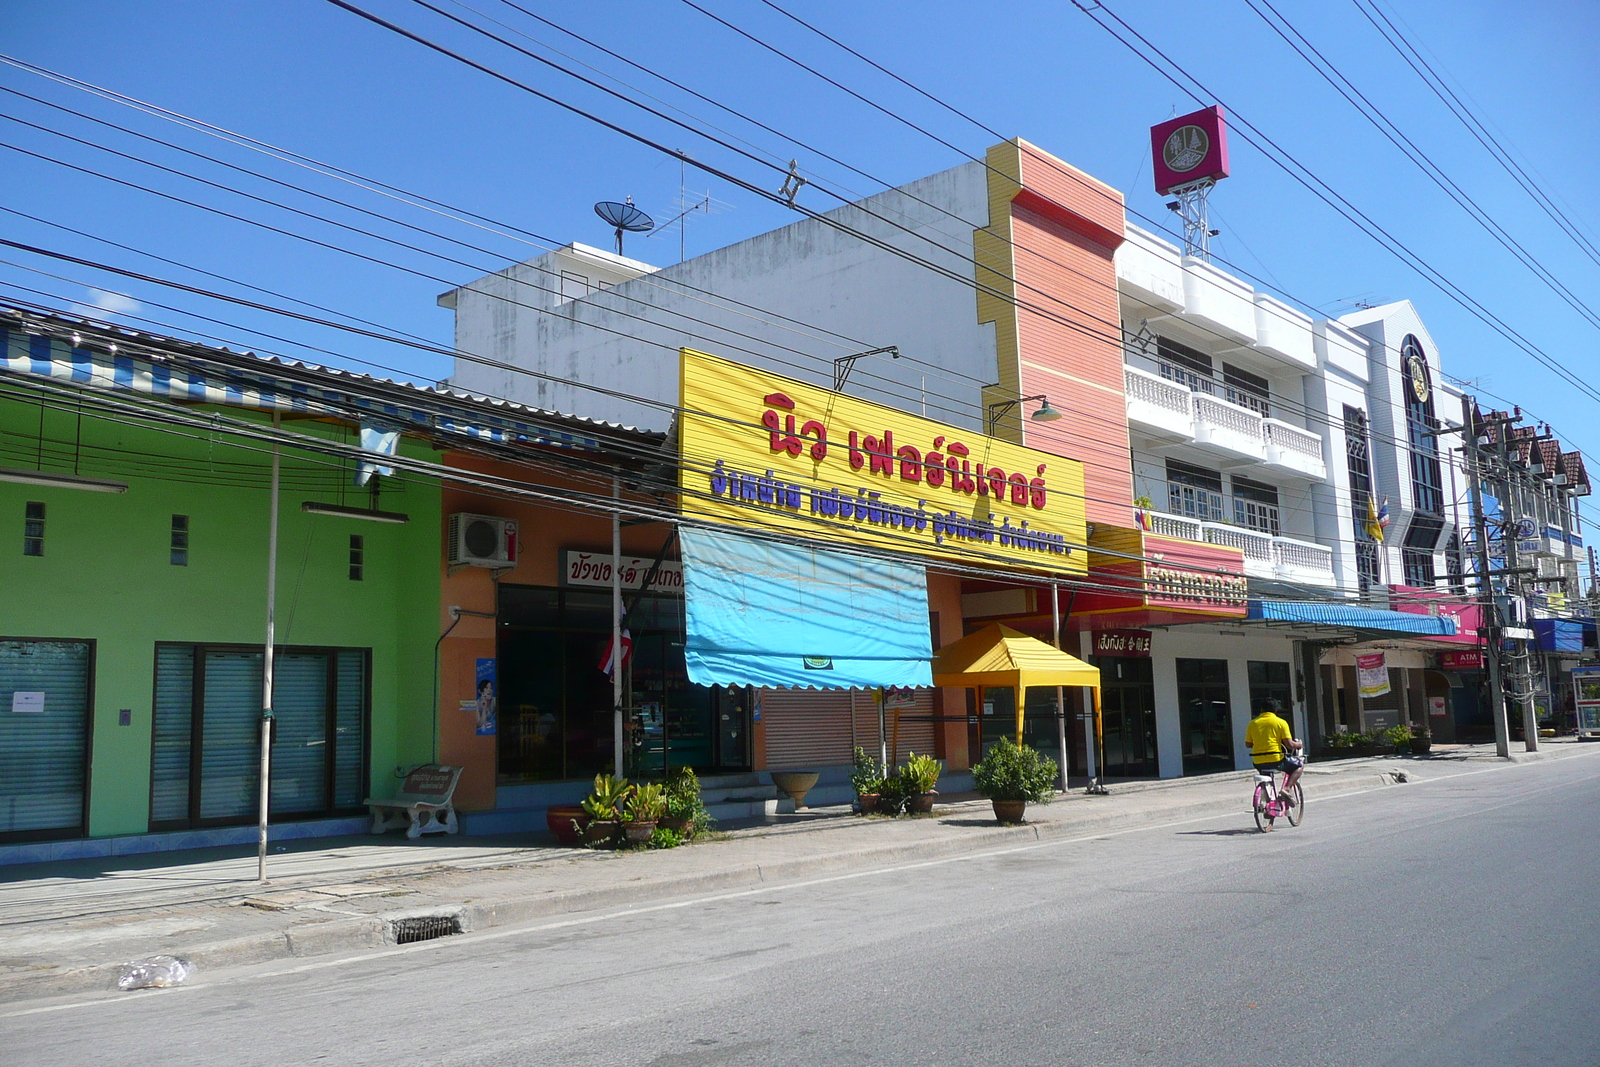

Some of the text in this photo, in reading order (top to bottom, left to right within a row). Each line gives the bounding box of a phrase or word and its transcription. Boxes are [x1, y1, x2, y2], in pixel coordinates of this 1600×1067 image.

[762, 392, 1047, 508] นิว เฟอร์นิเจอร์
[711, 459, 801, 508] จำหน่าย
[1460, 653, 1477, 661] ATM
